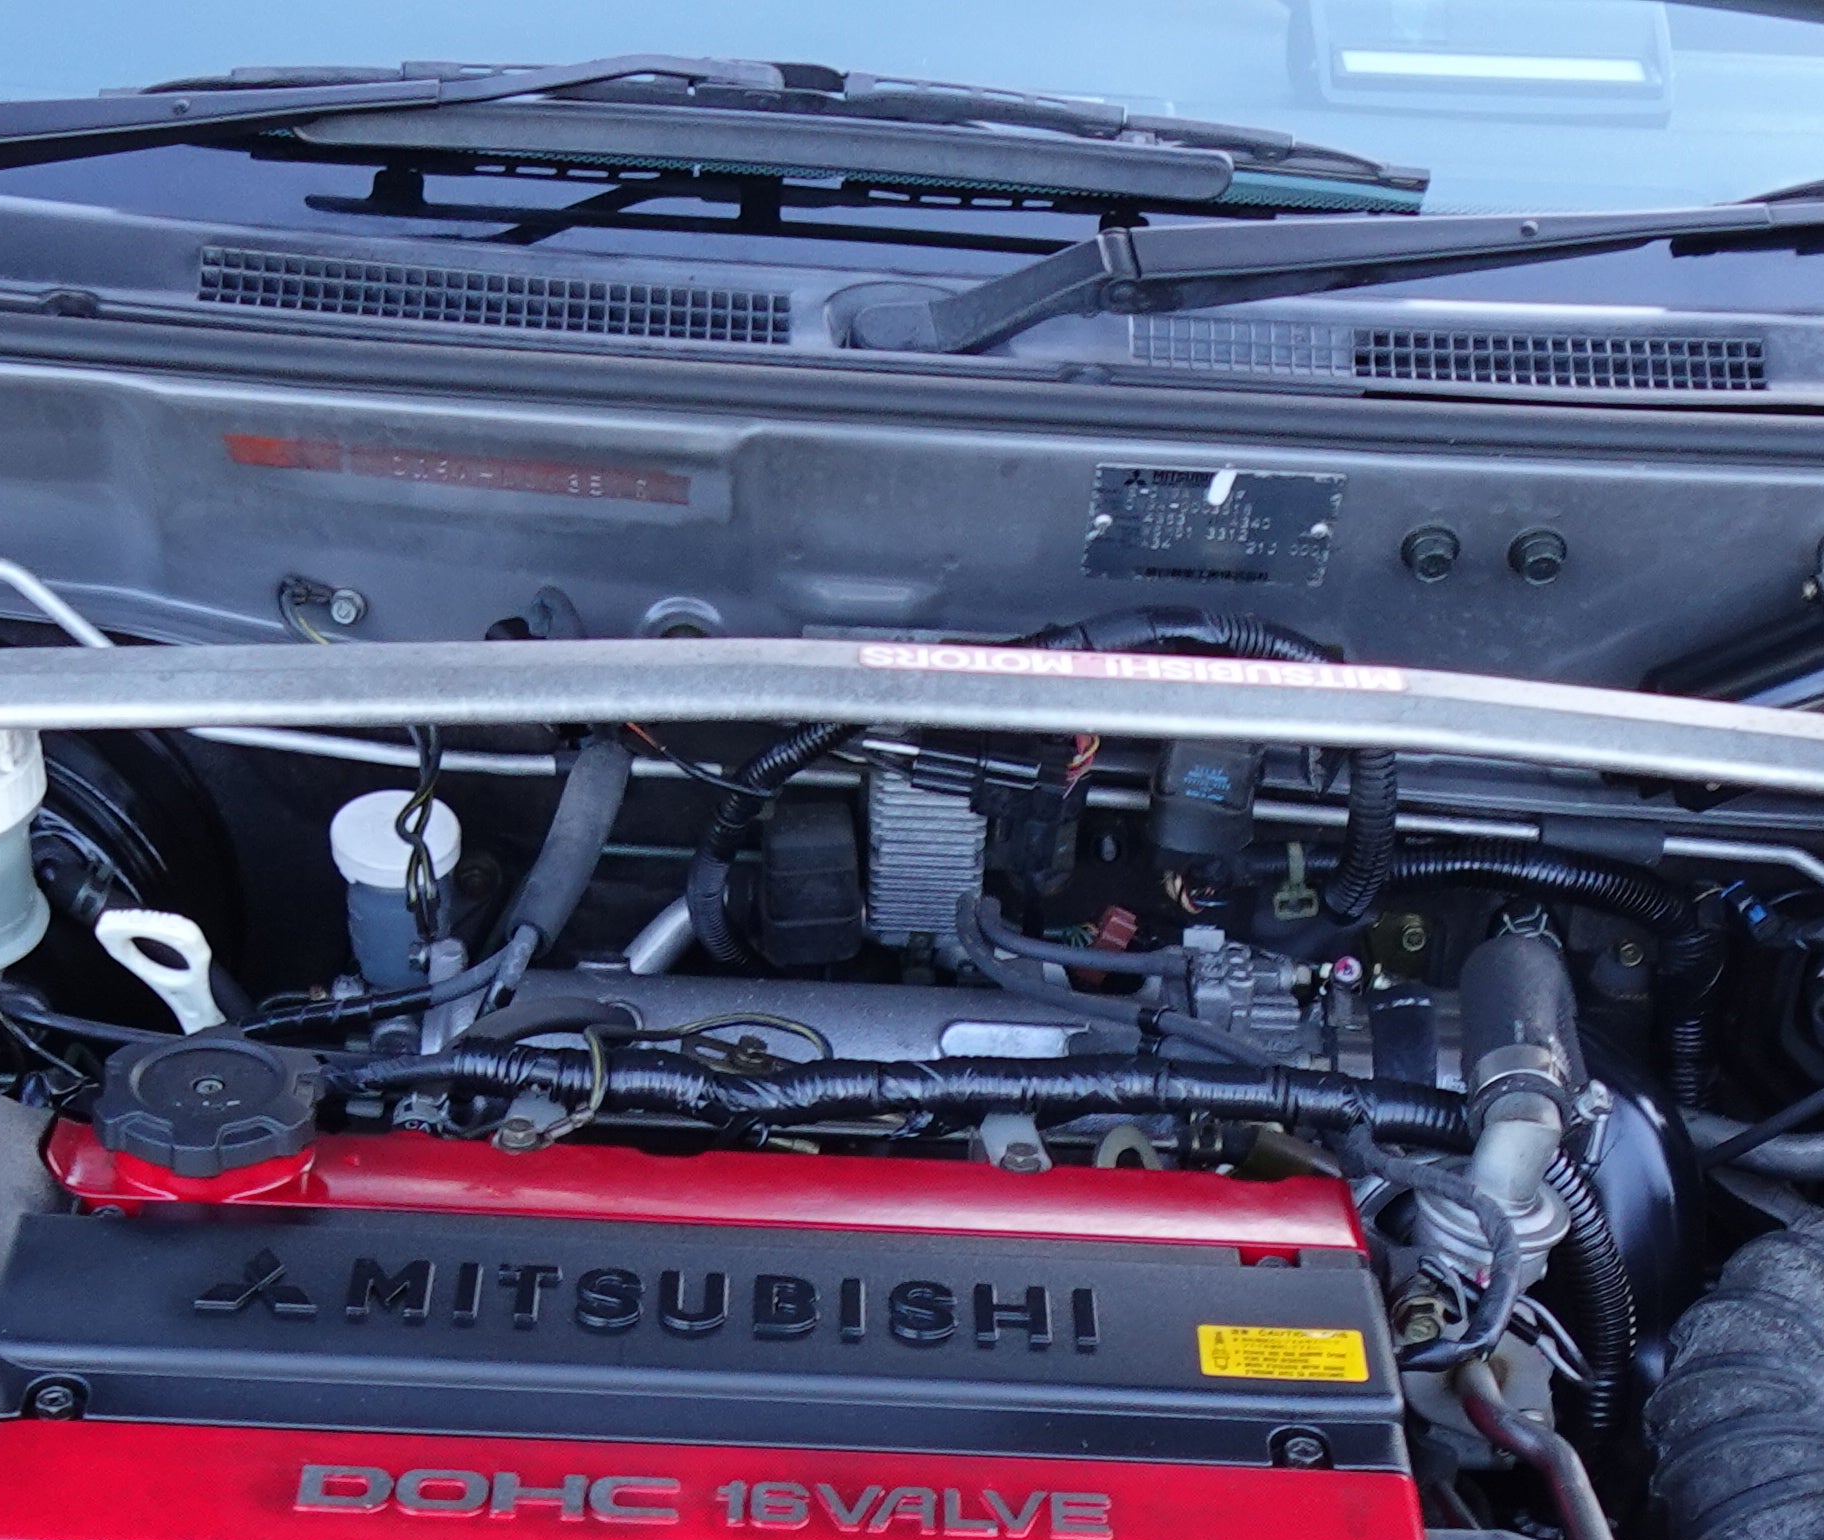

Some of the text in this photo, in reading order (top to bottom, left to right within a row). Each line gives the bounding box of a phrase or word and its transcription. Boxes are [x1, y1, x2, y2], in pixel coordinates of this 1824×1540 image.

[860, 645, 1406, 692] MITSUBISHI MOTORS
[347, 1256, 1100, 1351] MITSUBISHI
[293, 1464, 682, 1526] DOHC
